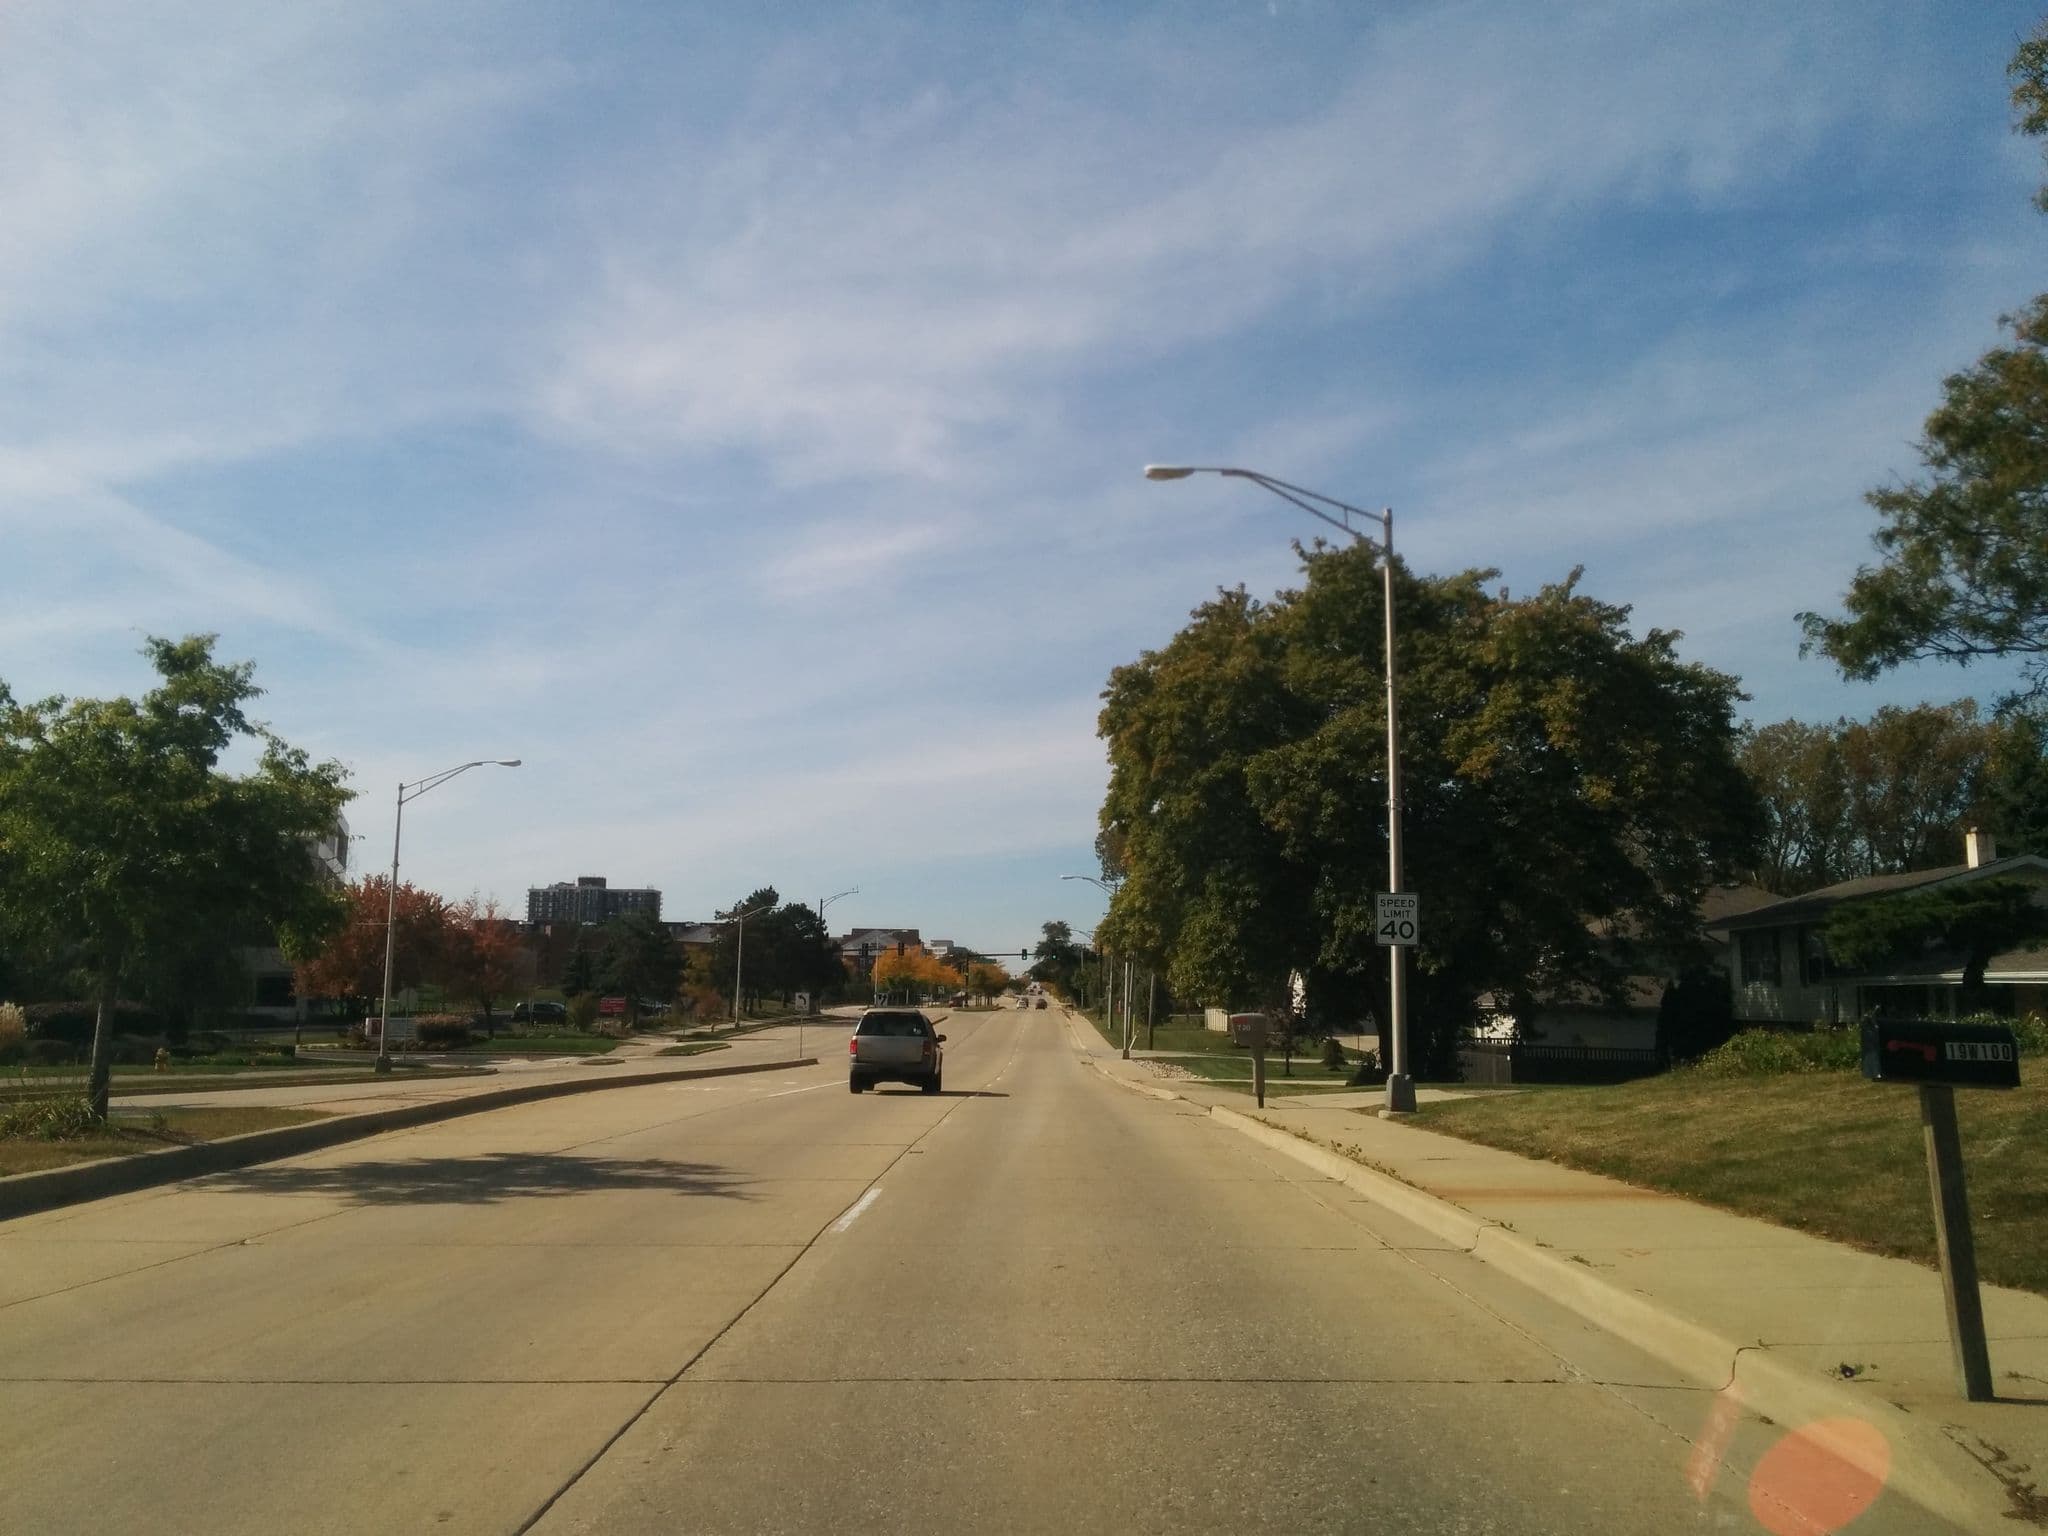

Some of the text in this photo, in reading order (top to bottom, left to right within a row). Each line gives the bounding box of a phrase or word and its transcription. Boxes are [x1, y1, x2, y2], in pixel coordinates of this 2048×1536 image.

[1380, 899, 1415, 908] SPEED
[1384, 910, 1411, 918] LIMIT
[1380, 920, 1414, 939] 40
[1949, 1044, 2010, 1060] 19W100
